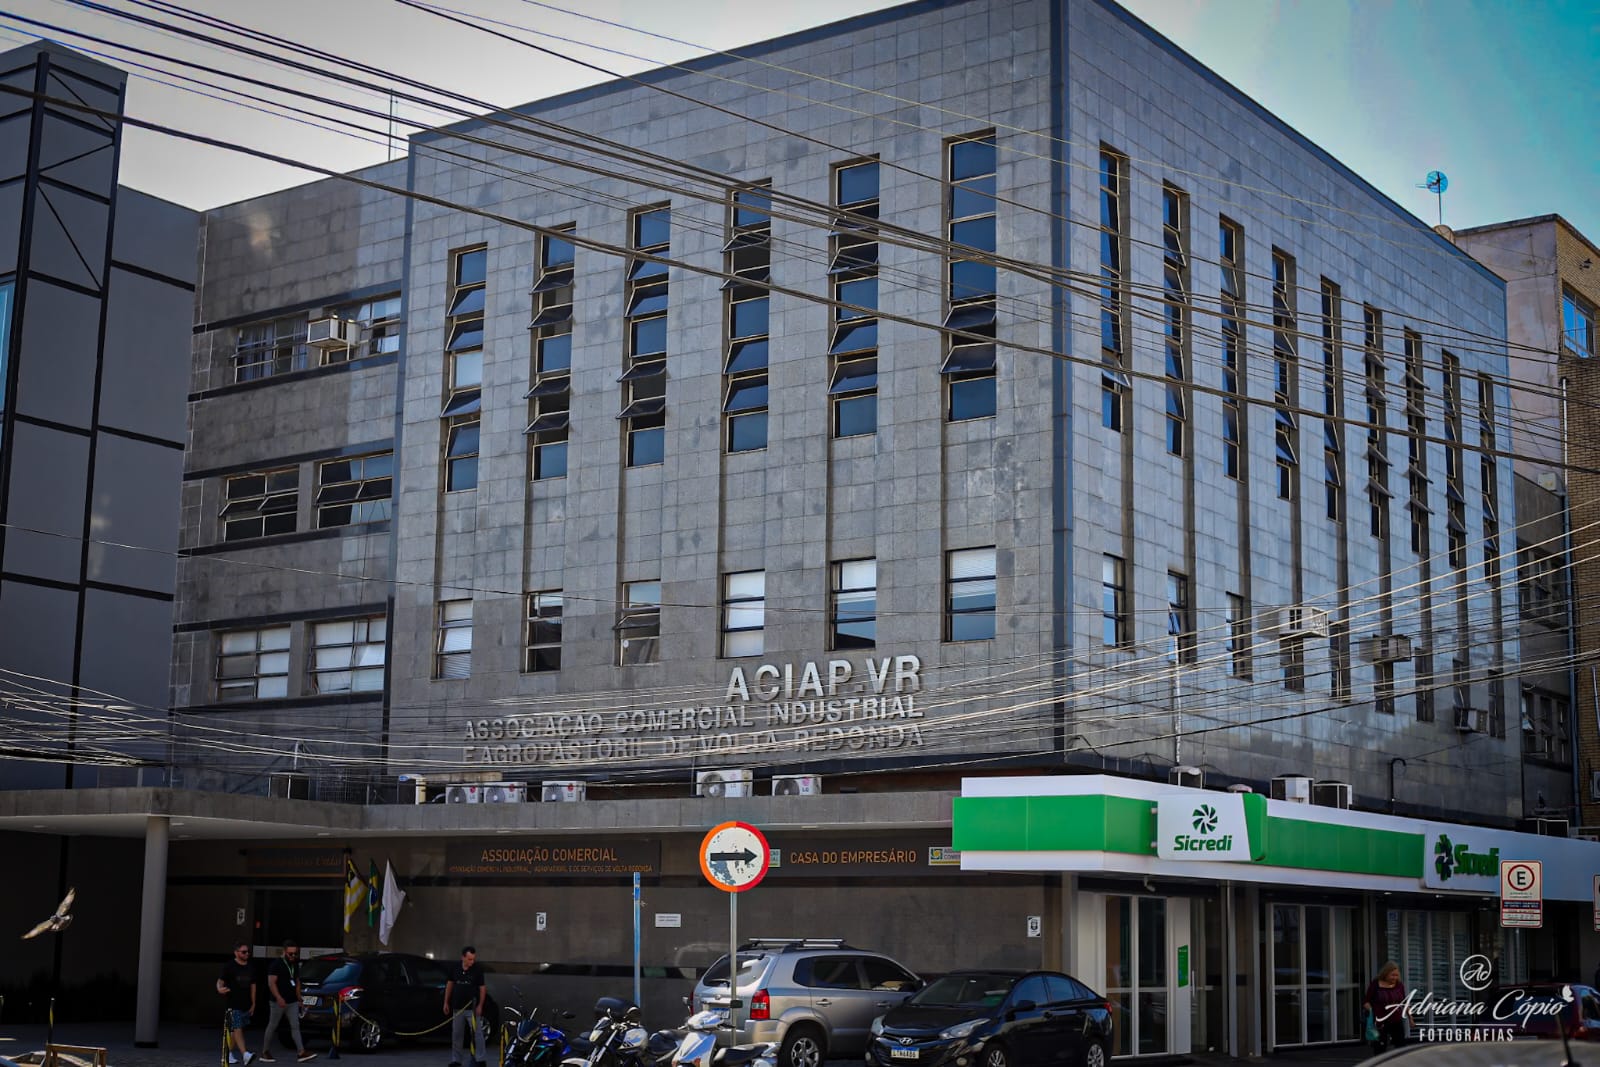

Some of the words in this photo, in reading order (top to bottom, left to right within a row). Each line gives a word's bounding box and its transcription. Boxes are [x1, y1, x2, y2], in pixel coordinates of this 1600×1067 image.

[725, 654, 921, 701] ACIAP.VR
[614, 704, 755, 734] COMERCIAL
[767, 694, 925, 726] INDUSTRIAL
[795, 724, 924, 752] REDONDA
[1173, 834, 1233, 851] Sicredi
[481, 846, 549, 864] ASSOCIAÇÃO
[552, 848, 618, 861] COMERCIAL
[790, 851, 819, 864] CASA
[822, 851, 837, 864] DO
[841, 848, 917, 864] EMPRESÁRIO
[1517, 871, 1526, 885] E
